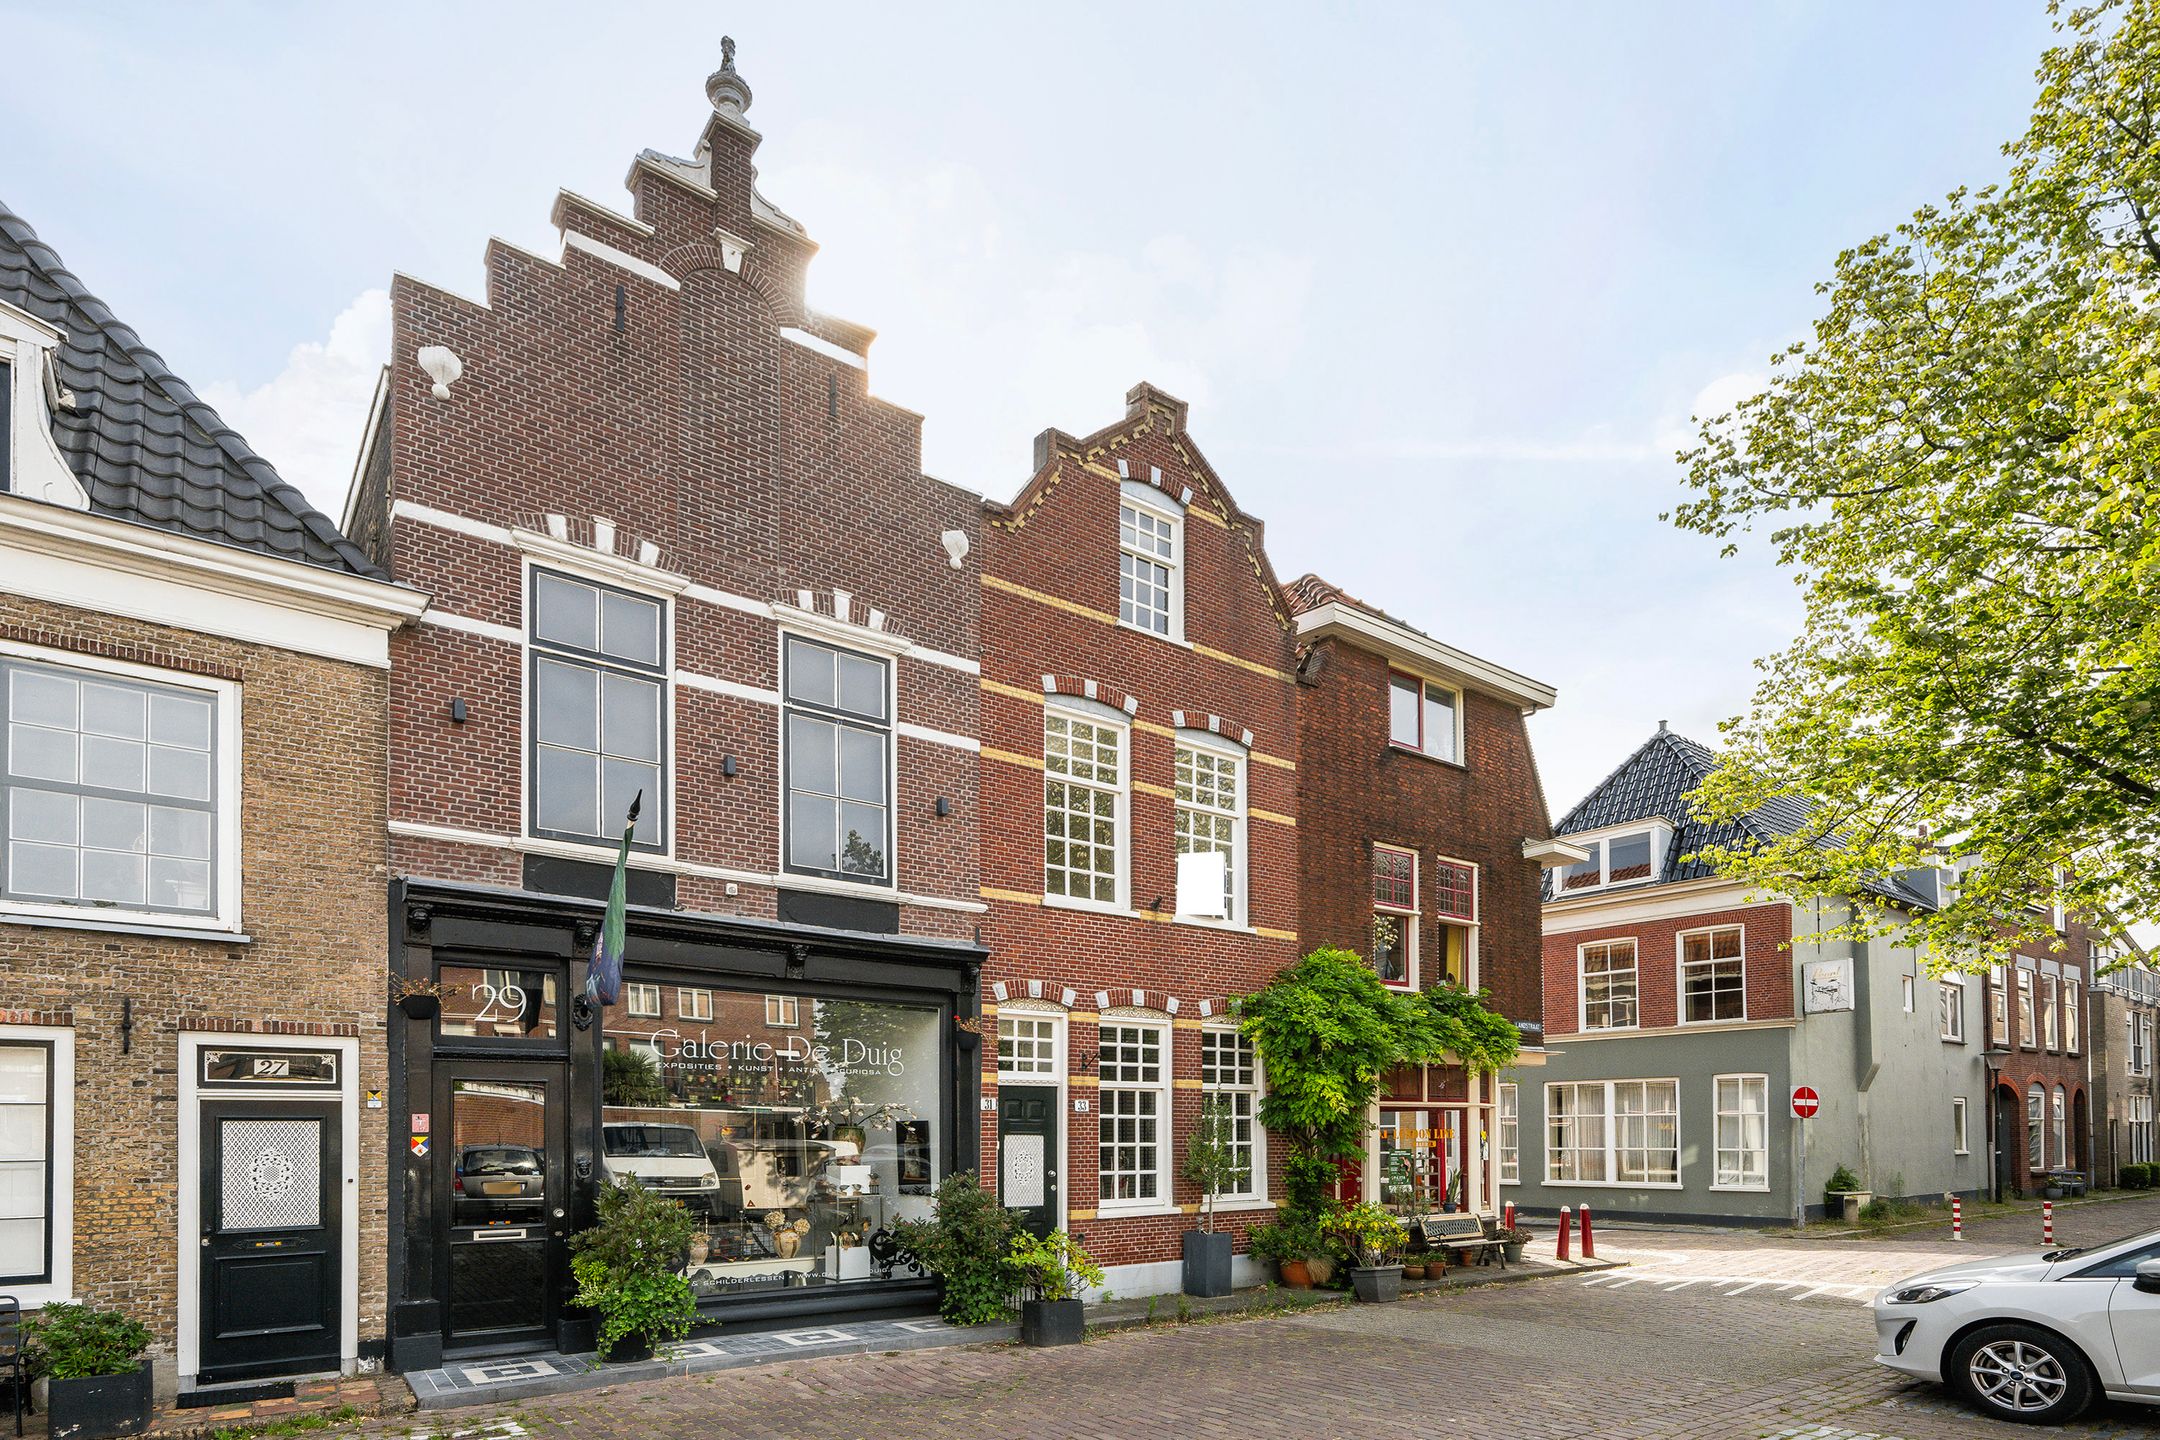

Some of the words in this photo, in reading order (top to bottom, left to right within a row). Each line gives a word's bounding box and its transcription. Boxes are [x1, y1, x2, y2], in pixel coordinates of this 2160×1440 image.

[472, 984, 527, 1023] 29
[650, 1028, 773, 1061] Galerie
[786, 1035, 830, 1063] De
[842, 1038, 904, 1077] Duig
[256, 1060, 288, 1075] 27
[655, 1061, 722, 1071] EXPOSITIES
[738, 1064, 774, 1072] KUNST
[839, 1068, 881, 1076] CURIOSA
[984, 1099, 993, 1110] 31
[1077, 1100, 1087, 1111] 33
[1434, 1127, 1455, 1139] LINE
[703, 1275, 785, 1287] SCHILDERLESSEN
